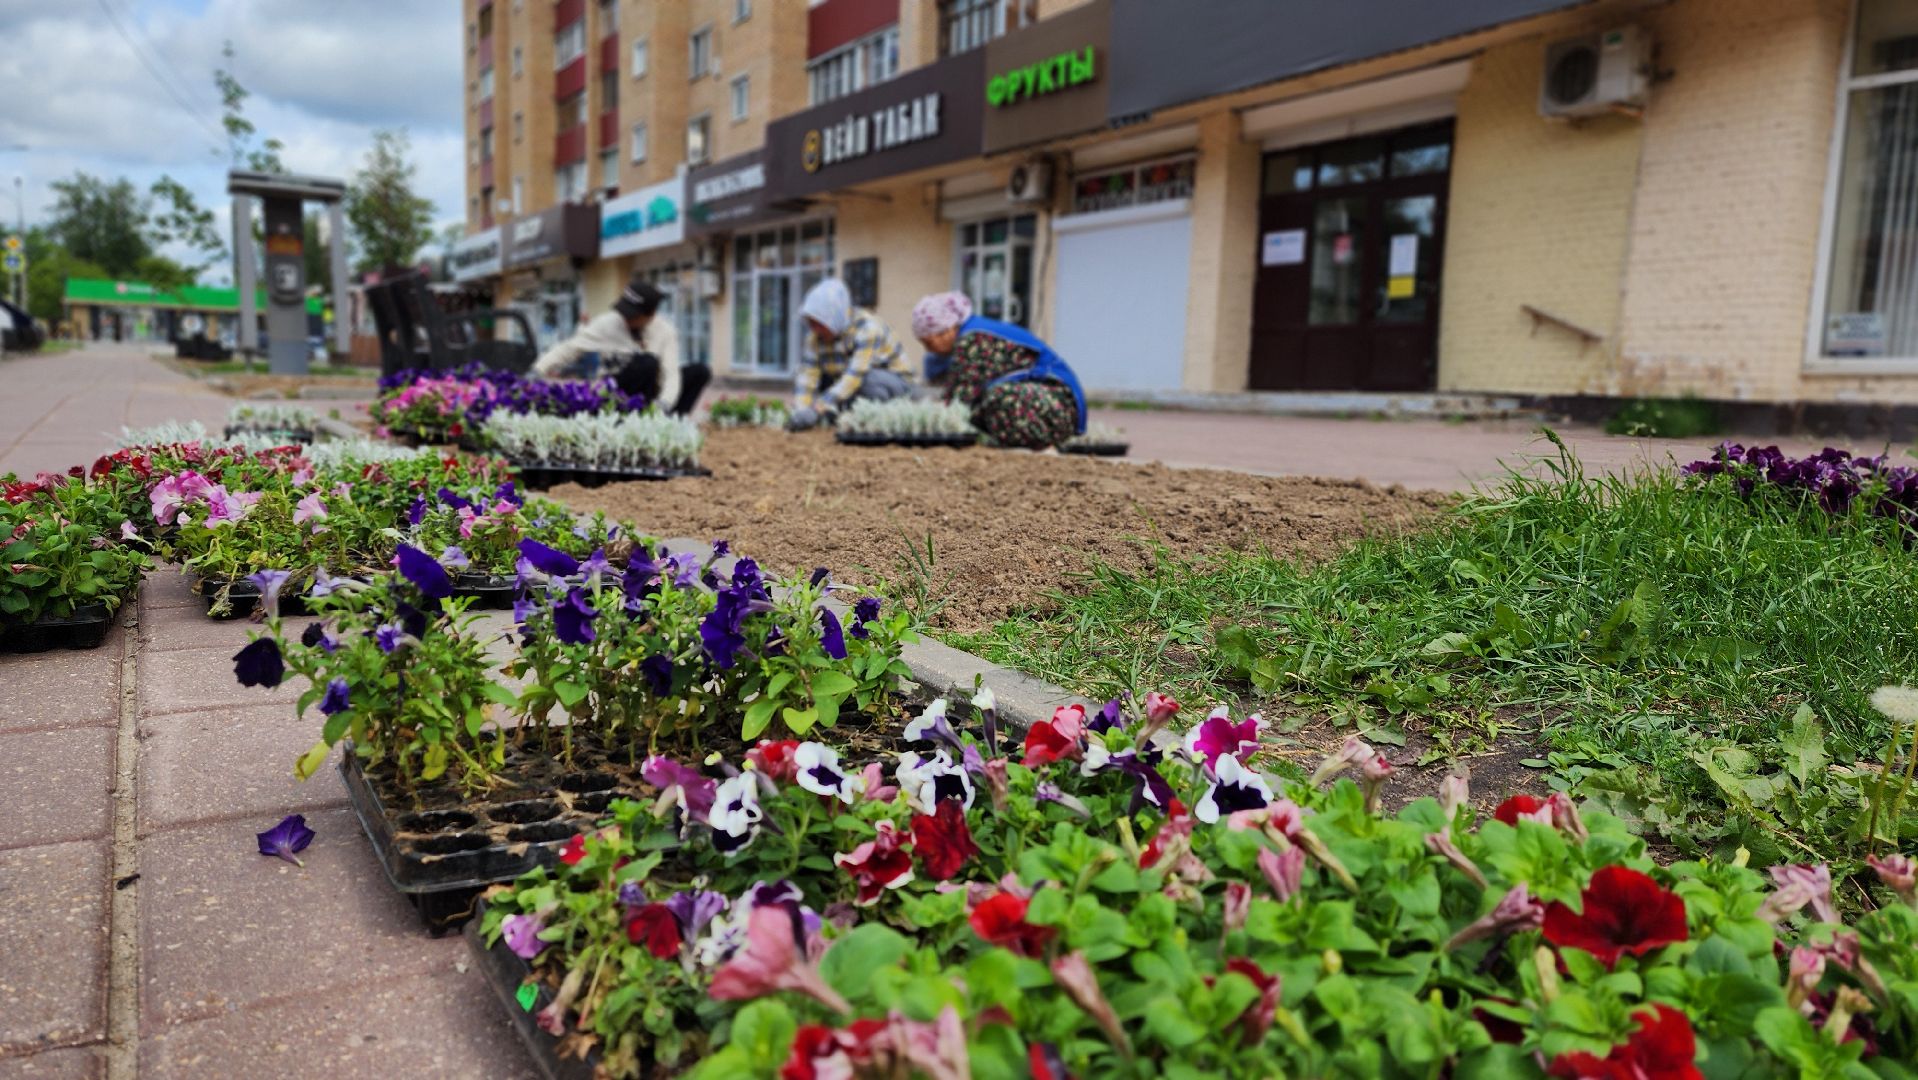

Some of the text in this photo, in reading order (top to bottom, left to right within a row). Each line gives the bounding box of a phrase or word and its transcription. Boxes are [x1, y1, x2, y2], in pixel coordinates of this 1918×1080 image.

[987, 46, 1095, 107] ФРУКТЫ
[823, 92, 940, 165] ВЕЙП ТАБАК
